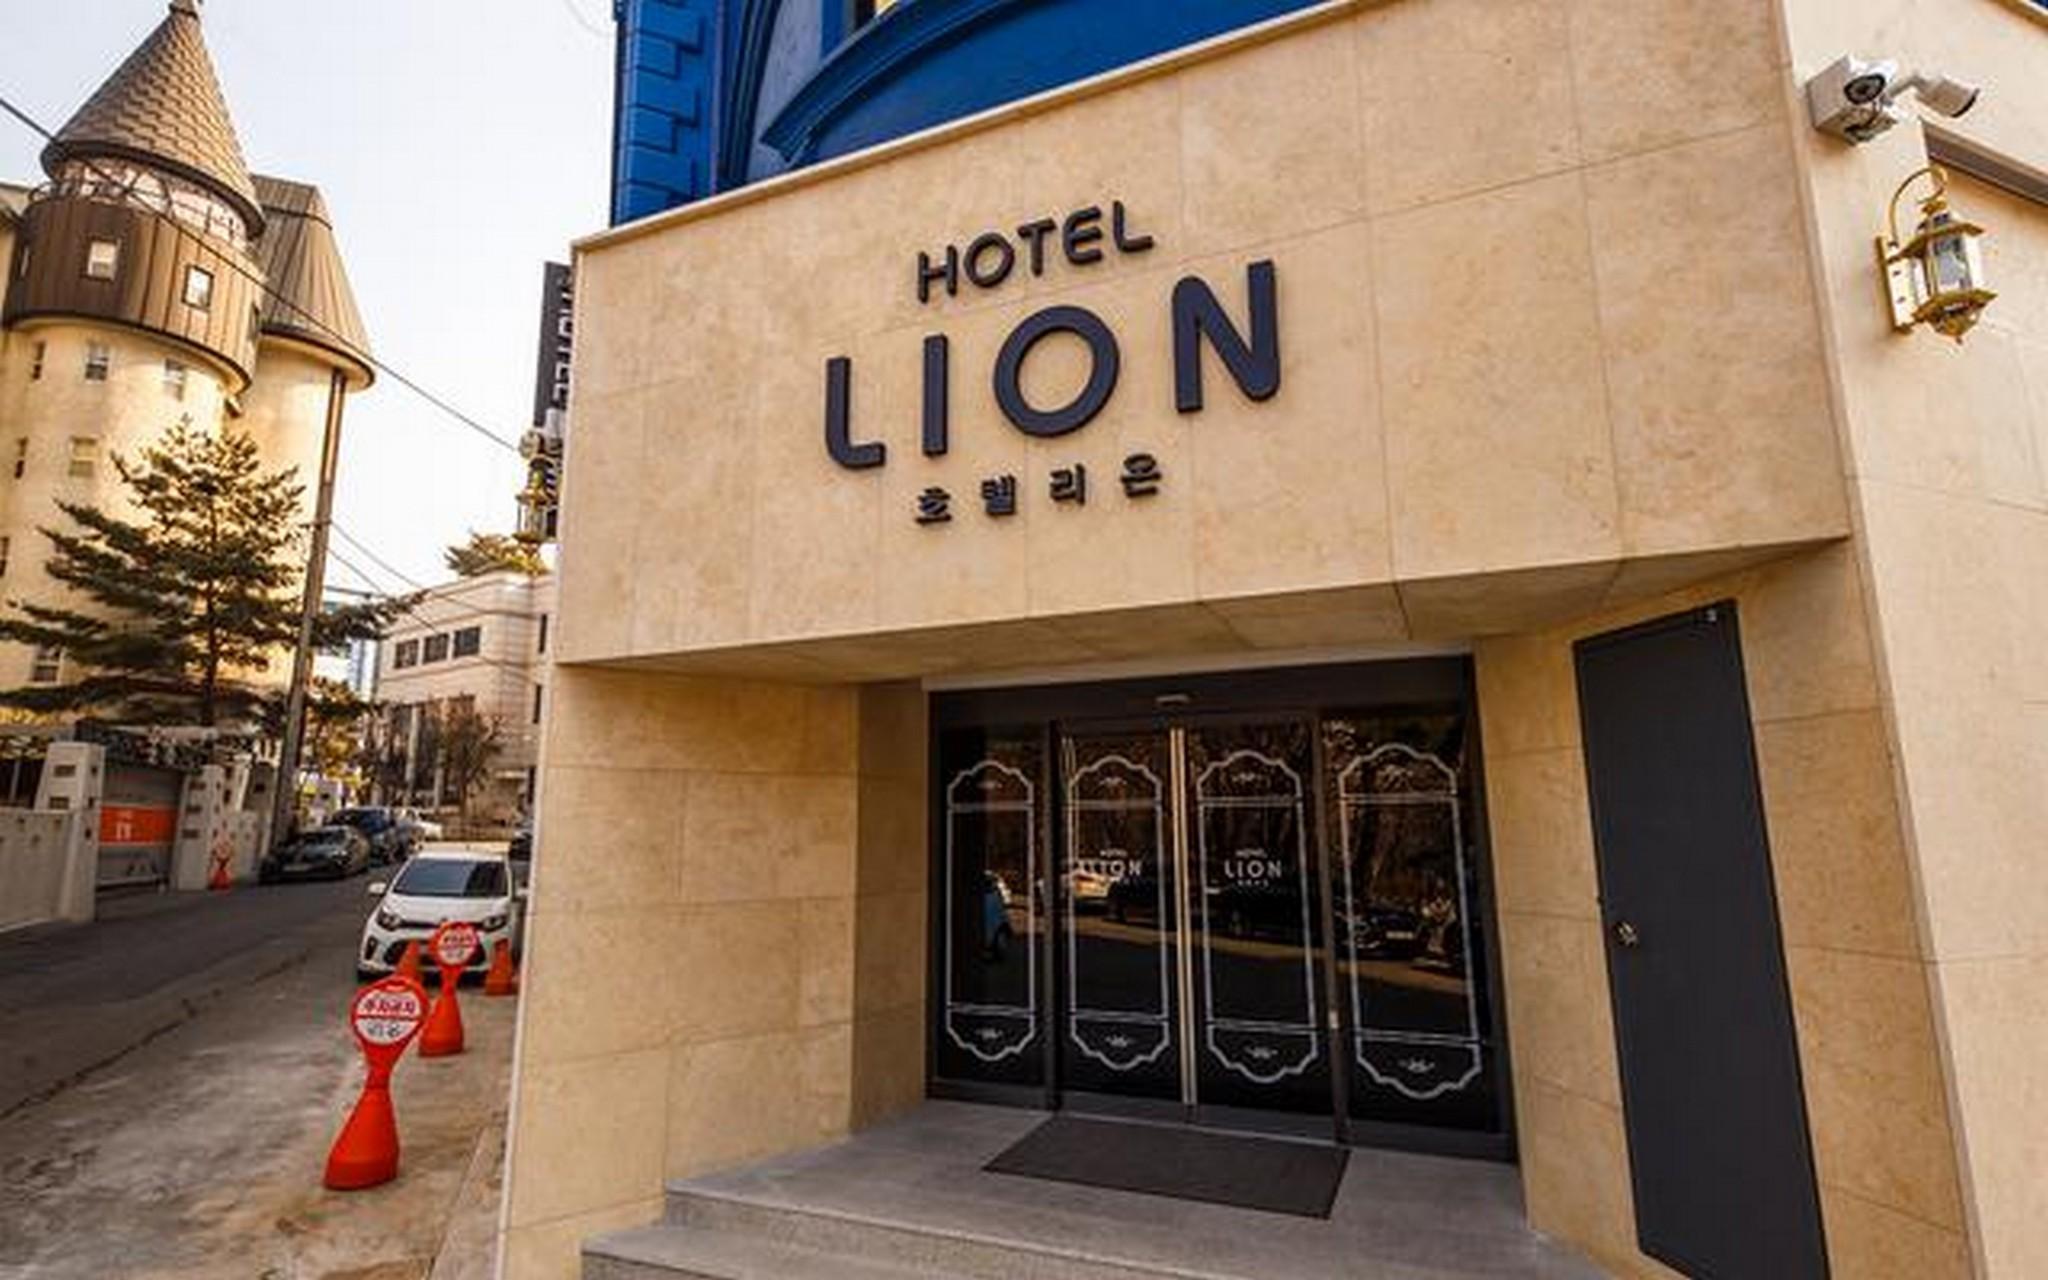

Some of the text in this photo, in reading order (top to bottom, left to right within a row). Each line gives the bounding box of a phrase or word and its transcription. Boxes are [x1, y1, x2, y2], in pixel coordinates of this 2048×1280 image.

[917, 201, 1155, 303] HOTEL
[825, 259, 1281, 470] LION
[1224, 859, 1282, 879] LION
